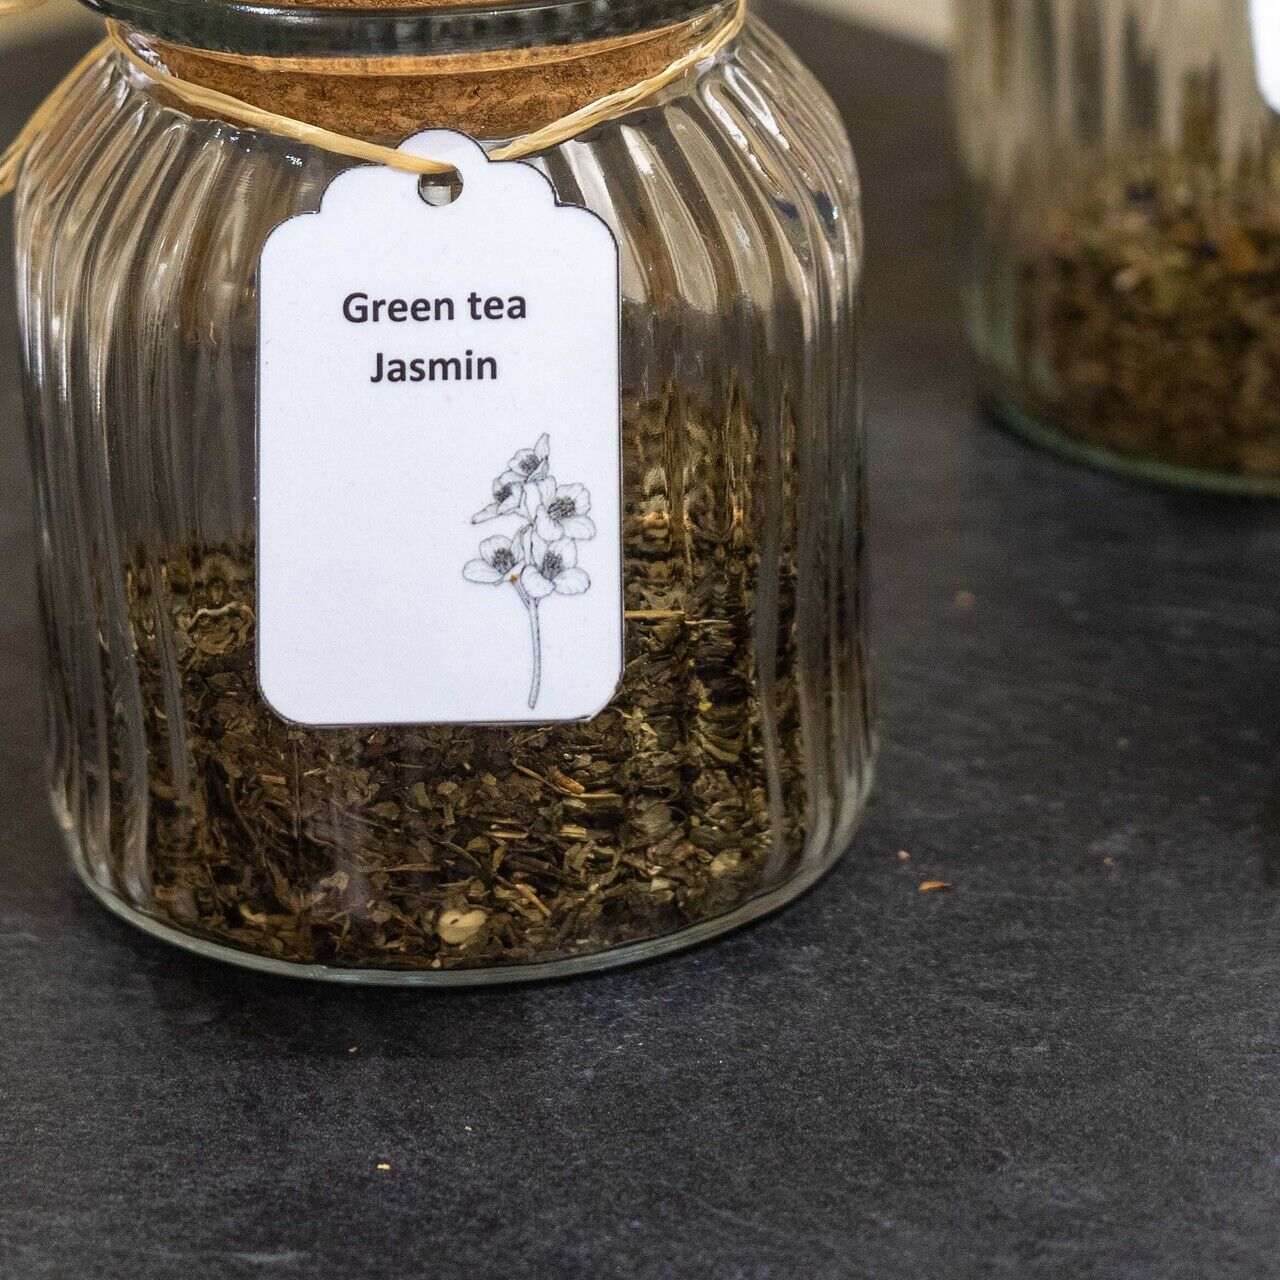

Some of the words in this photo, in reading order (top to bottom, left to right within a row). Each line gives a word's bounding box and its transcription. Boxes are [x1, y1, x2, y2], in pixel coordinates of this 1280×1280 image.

[343, 292, 454, 323] Green
[467, 292, 526, 320] tea
[370, 350, 497, 383] Jasmin
